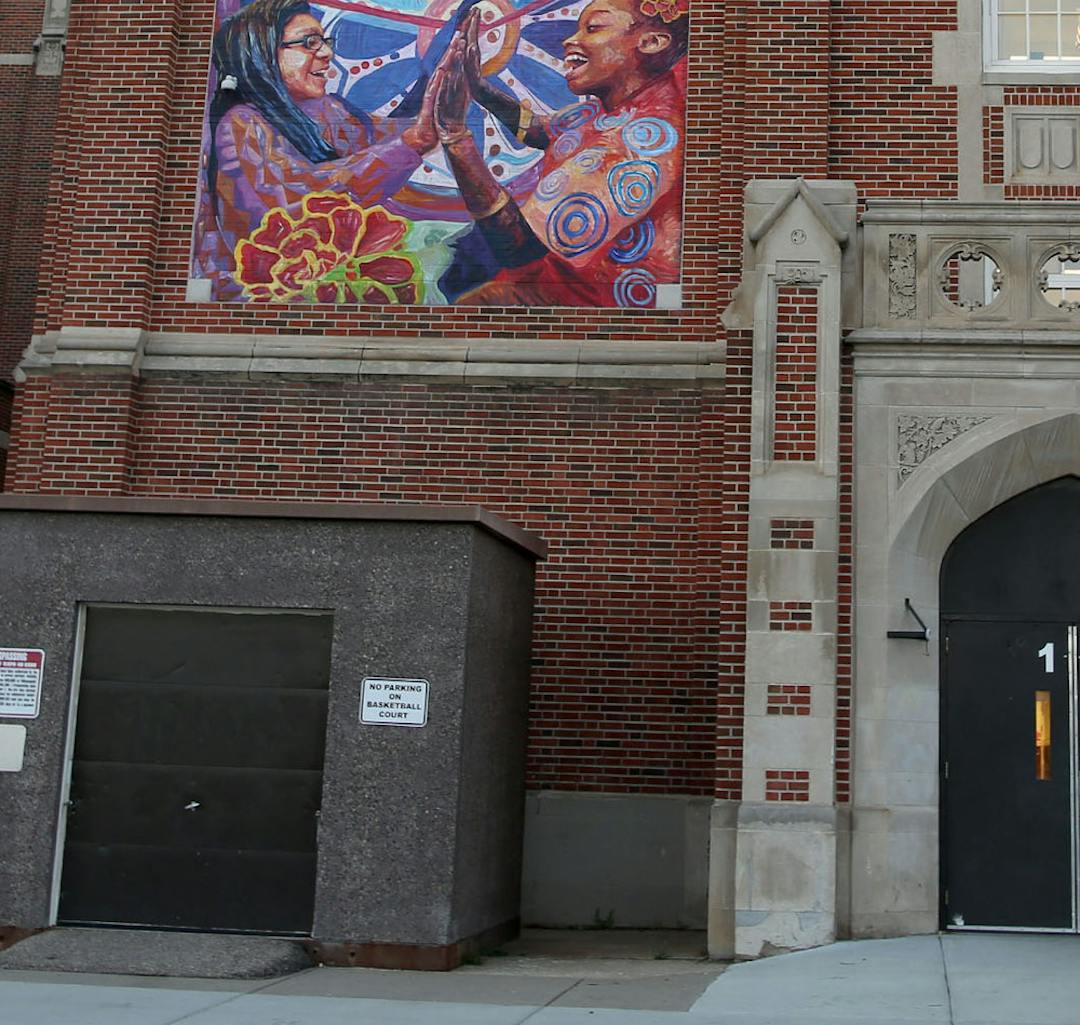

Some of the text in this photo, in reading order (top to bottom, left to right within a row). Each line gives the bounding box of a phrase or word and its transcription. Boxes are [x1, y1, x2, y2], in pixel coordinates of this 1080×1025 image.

[1038, 642, 1055, 673] 1
[369, 683, 422, 693] NO PARKING
[389, 693, 402, 701] ON
[366, 701, 422, 711] BASKETBALL
[379, 711, 409, 719] COURT
